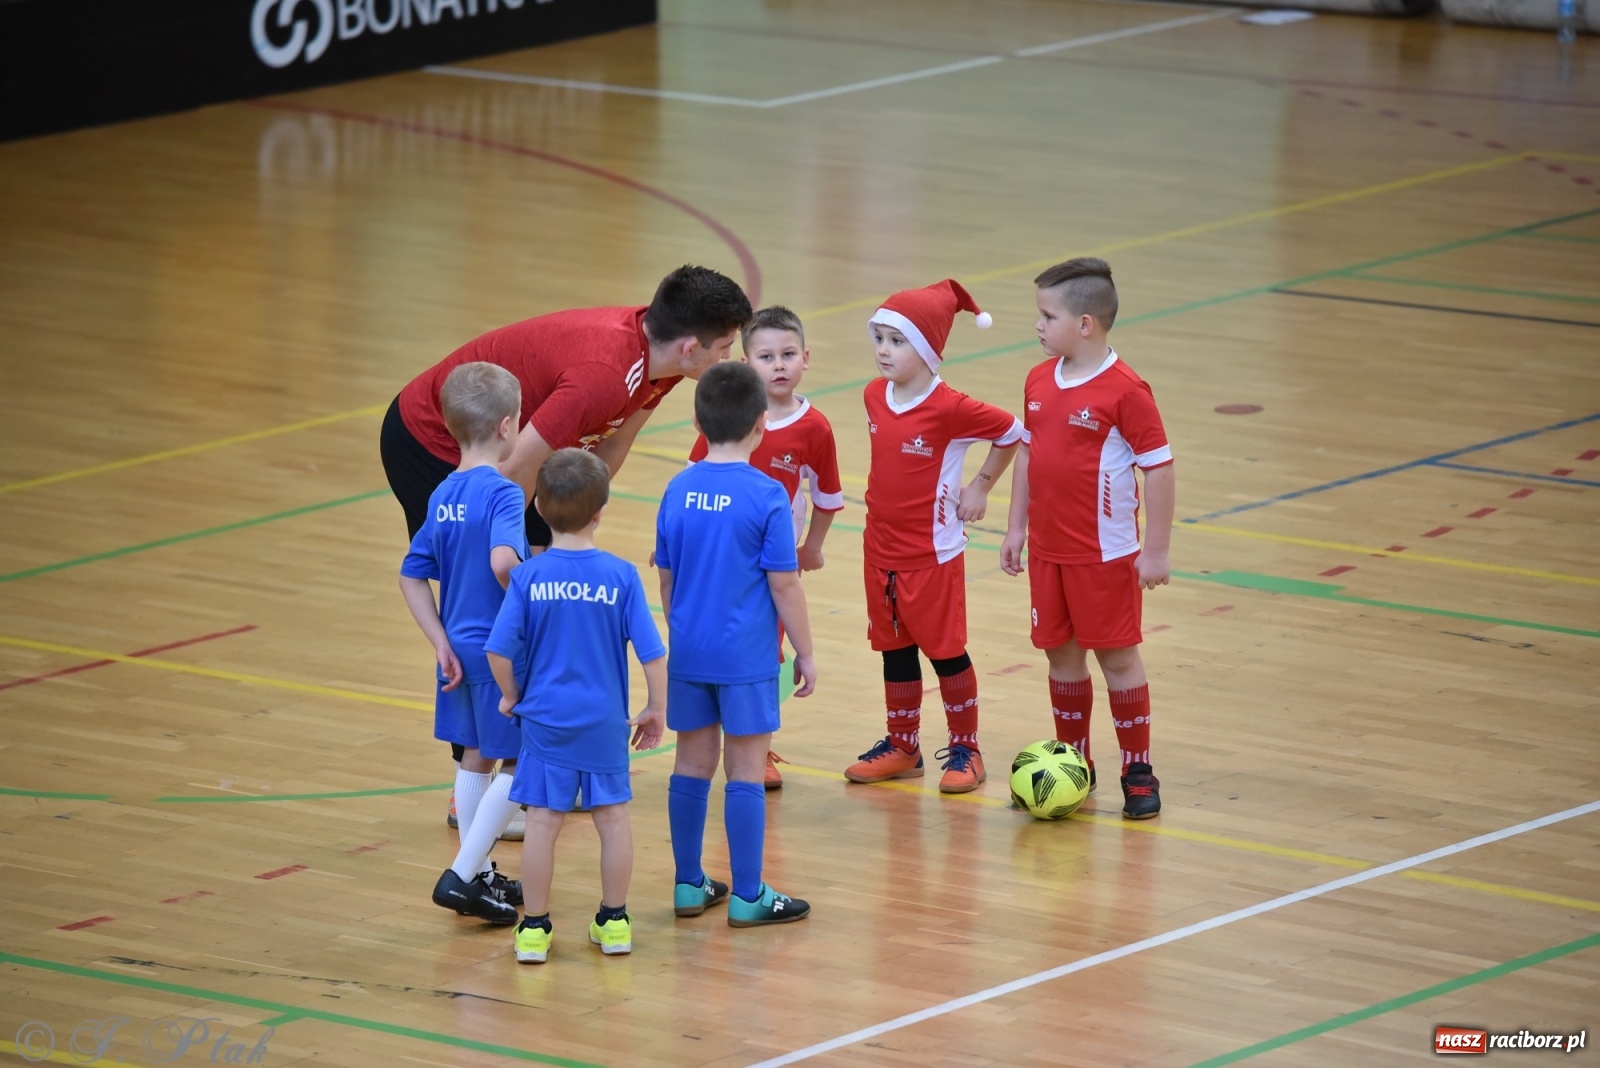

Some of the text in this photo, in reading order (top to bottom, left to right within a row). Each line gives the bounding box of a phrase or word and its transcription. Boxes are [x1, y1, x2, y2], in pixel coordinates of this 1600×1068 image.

[436, 503, 467, 523] OLE
[685, 491, 732, 513] FILIP
[530, 581, 619, 606] MIKOŁAJ
